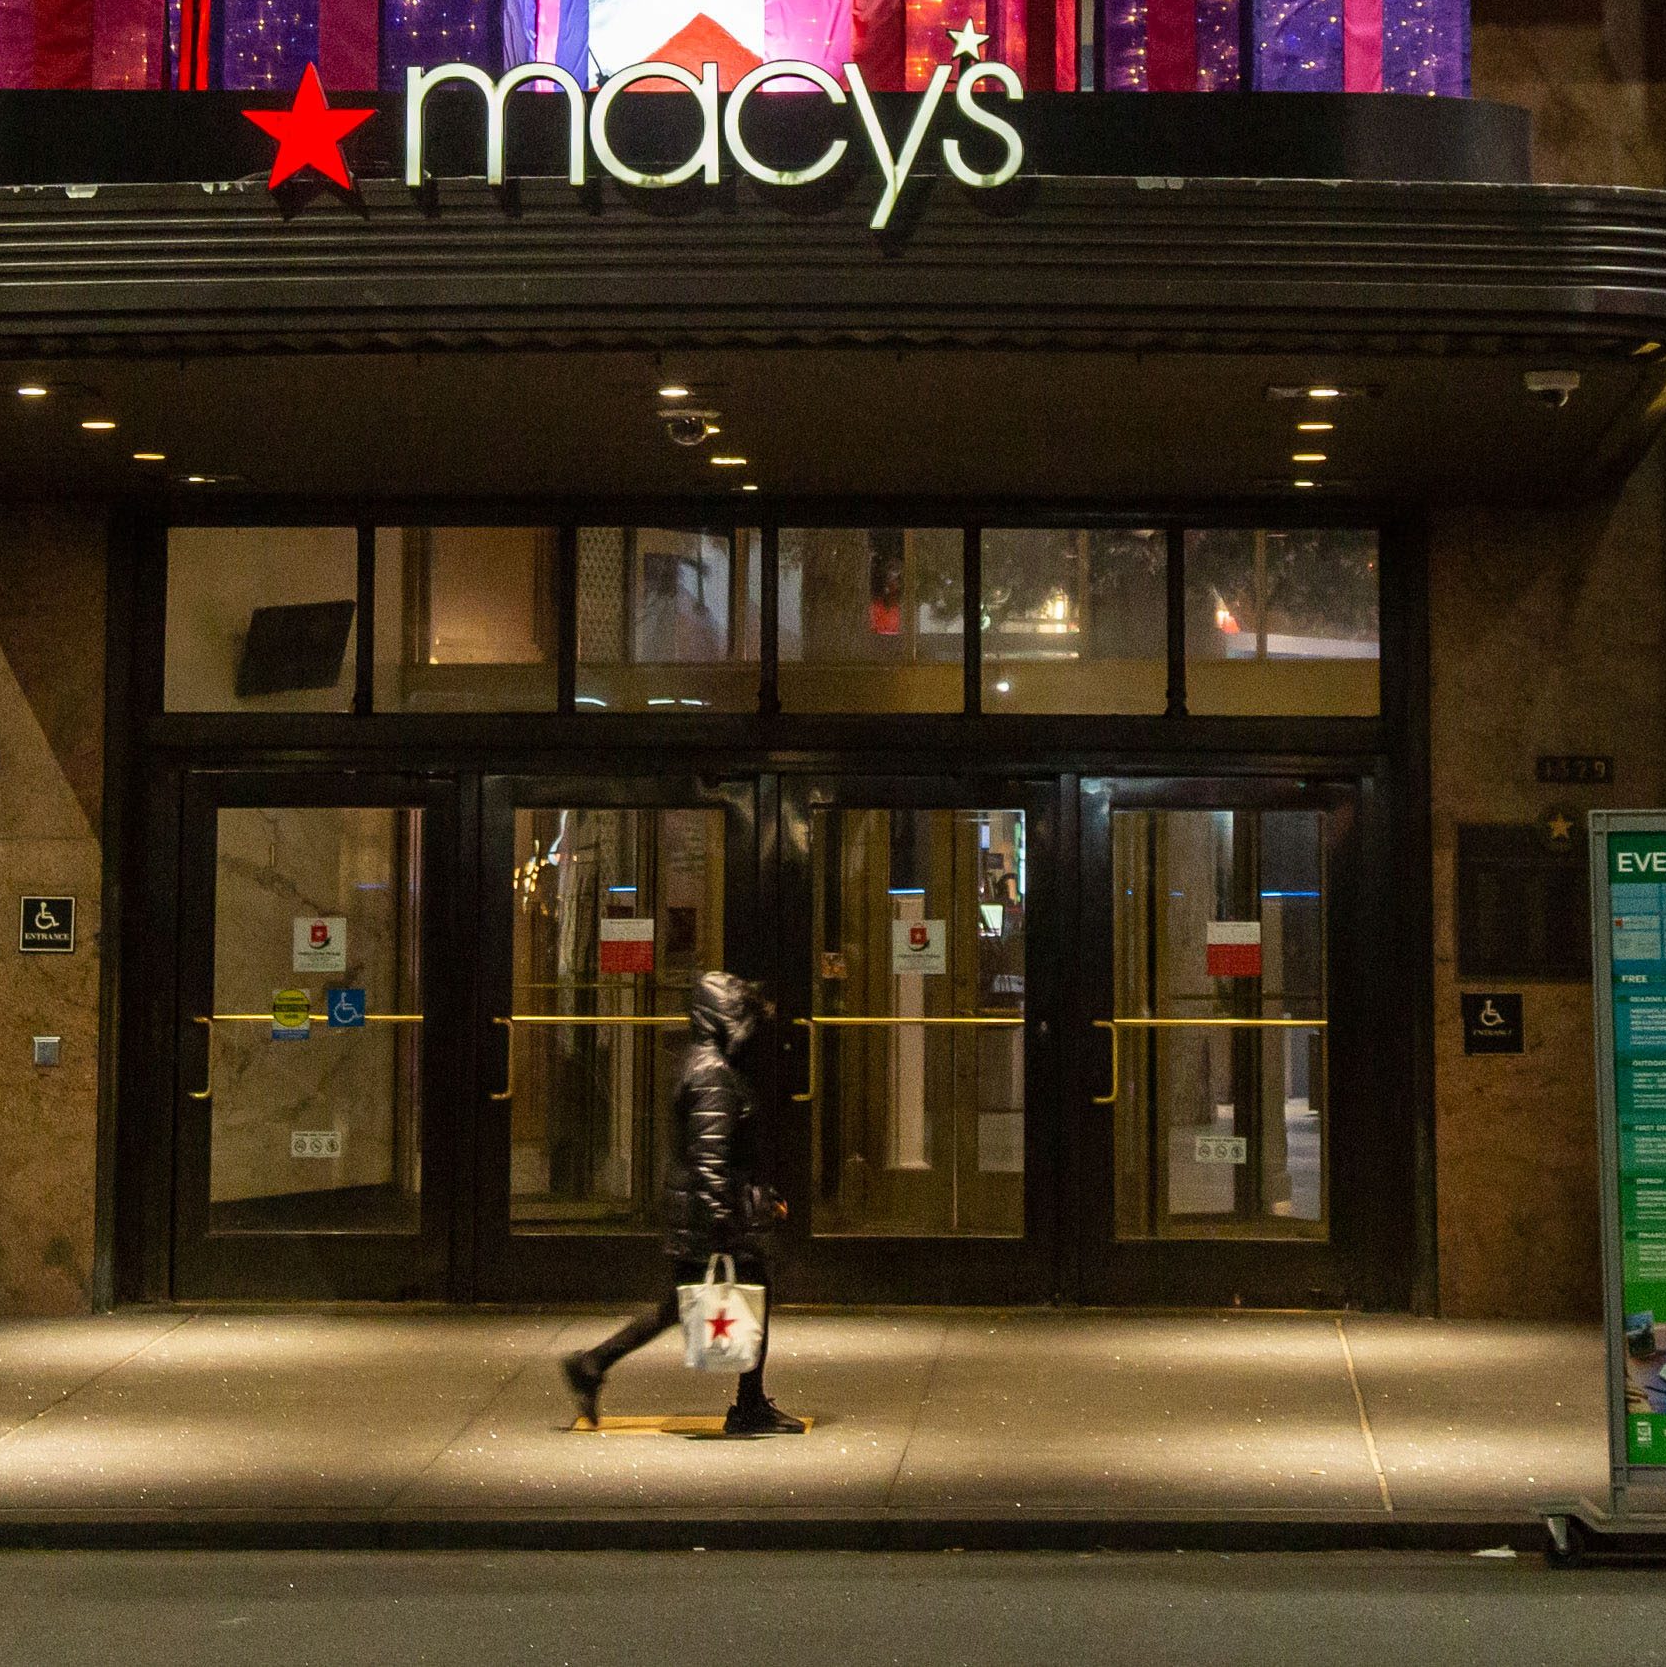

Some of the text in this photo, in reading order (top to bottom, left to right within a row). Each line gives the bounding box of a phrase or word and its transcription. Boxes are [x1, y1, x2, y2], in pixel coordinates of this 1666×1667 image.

[405, 16, 1025, 230] macy's
[24, 932, 69, 942] ENTRANCE
[1621, 974, 1649, 983] FREE
